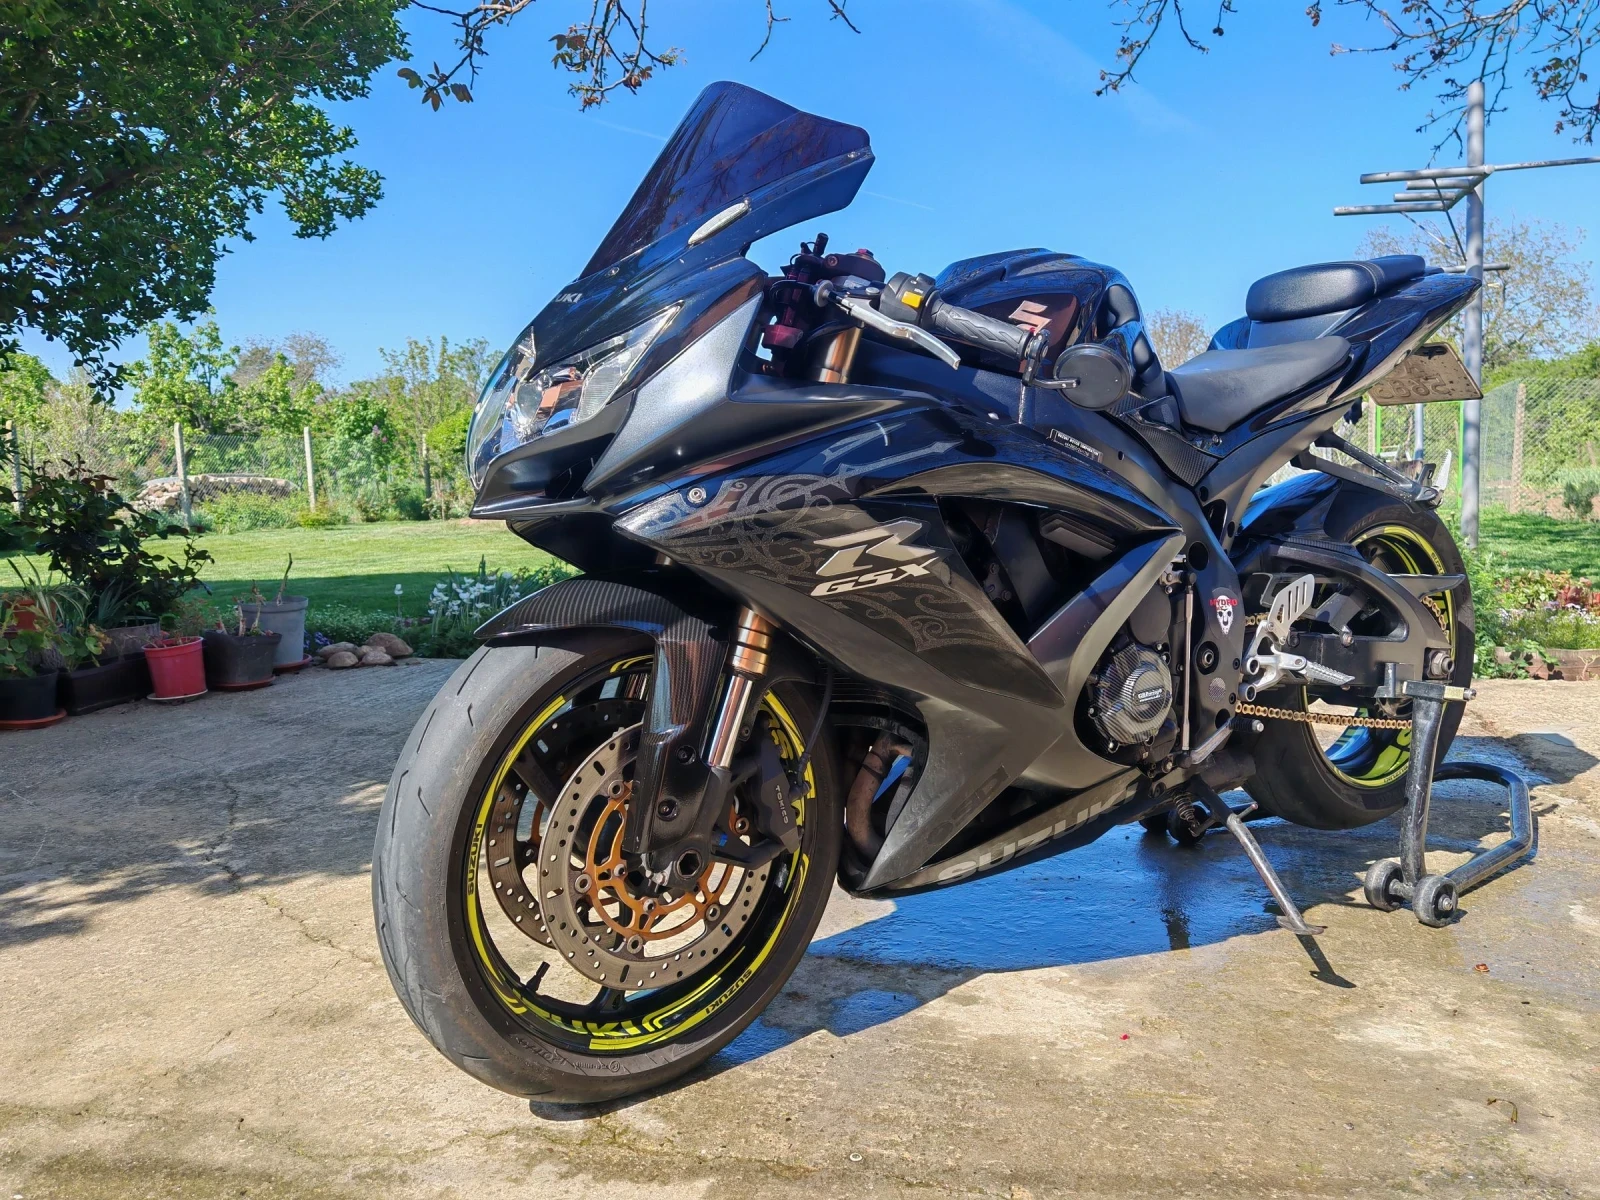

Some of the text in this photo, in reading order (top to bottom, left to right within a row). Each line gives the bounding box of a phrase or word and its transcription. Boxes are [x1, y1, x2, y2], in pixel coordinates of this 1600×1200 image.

[553, 293, 583, 304] UKI
[810, 556, 939, 597] GSX
[936, 782, 1139, 886] SUZUKI
[467, 823, 483, 896] SUZUKI
[705, 969, 752, 1014] SUZUKI
